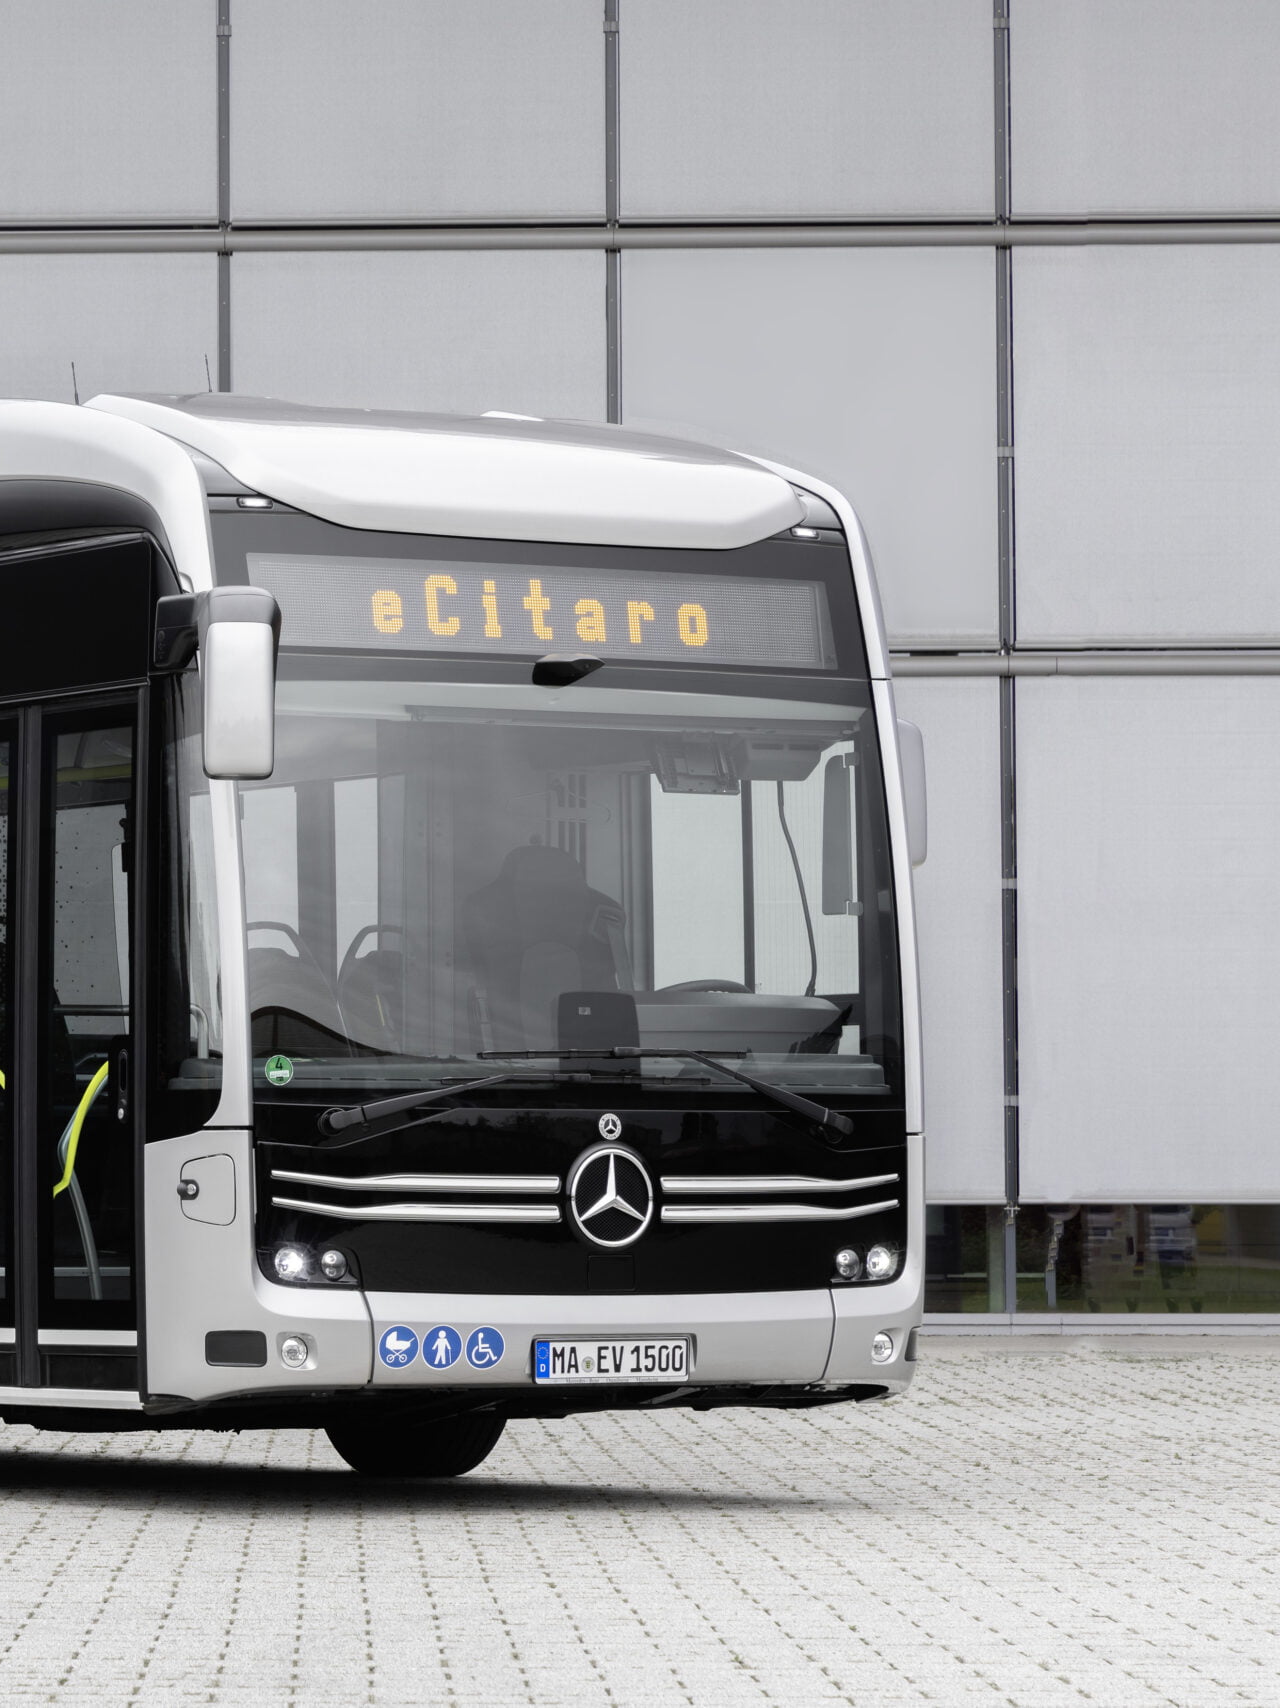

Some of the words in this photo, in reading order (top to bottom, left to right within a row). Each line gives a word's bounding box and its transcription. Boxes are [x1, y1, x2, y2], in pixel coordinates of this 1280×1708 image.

[376, 576, 707, 647] eCitaro
[275, 1057, 283, 1070] 4
[540, 1363, 546, 1373] D
[552, 1346, 579, 1374] MA
[597, 1346, 624, 1373] EV
[630, 1345, 683, 1373] 1500
